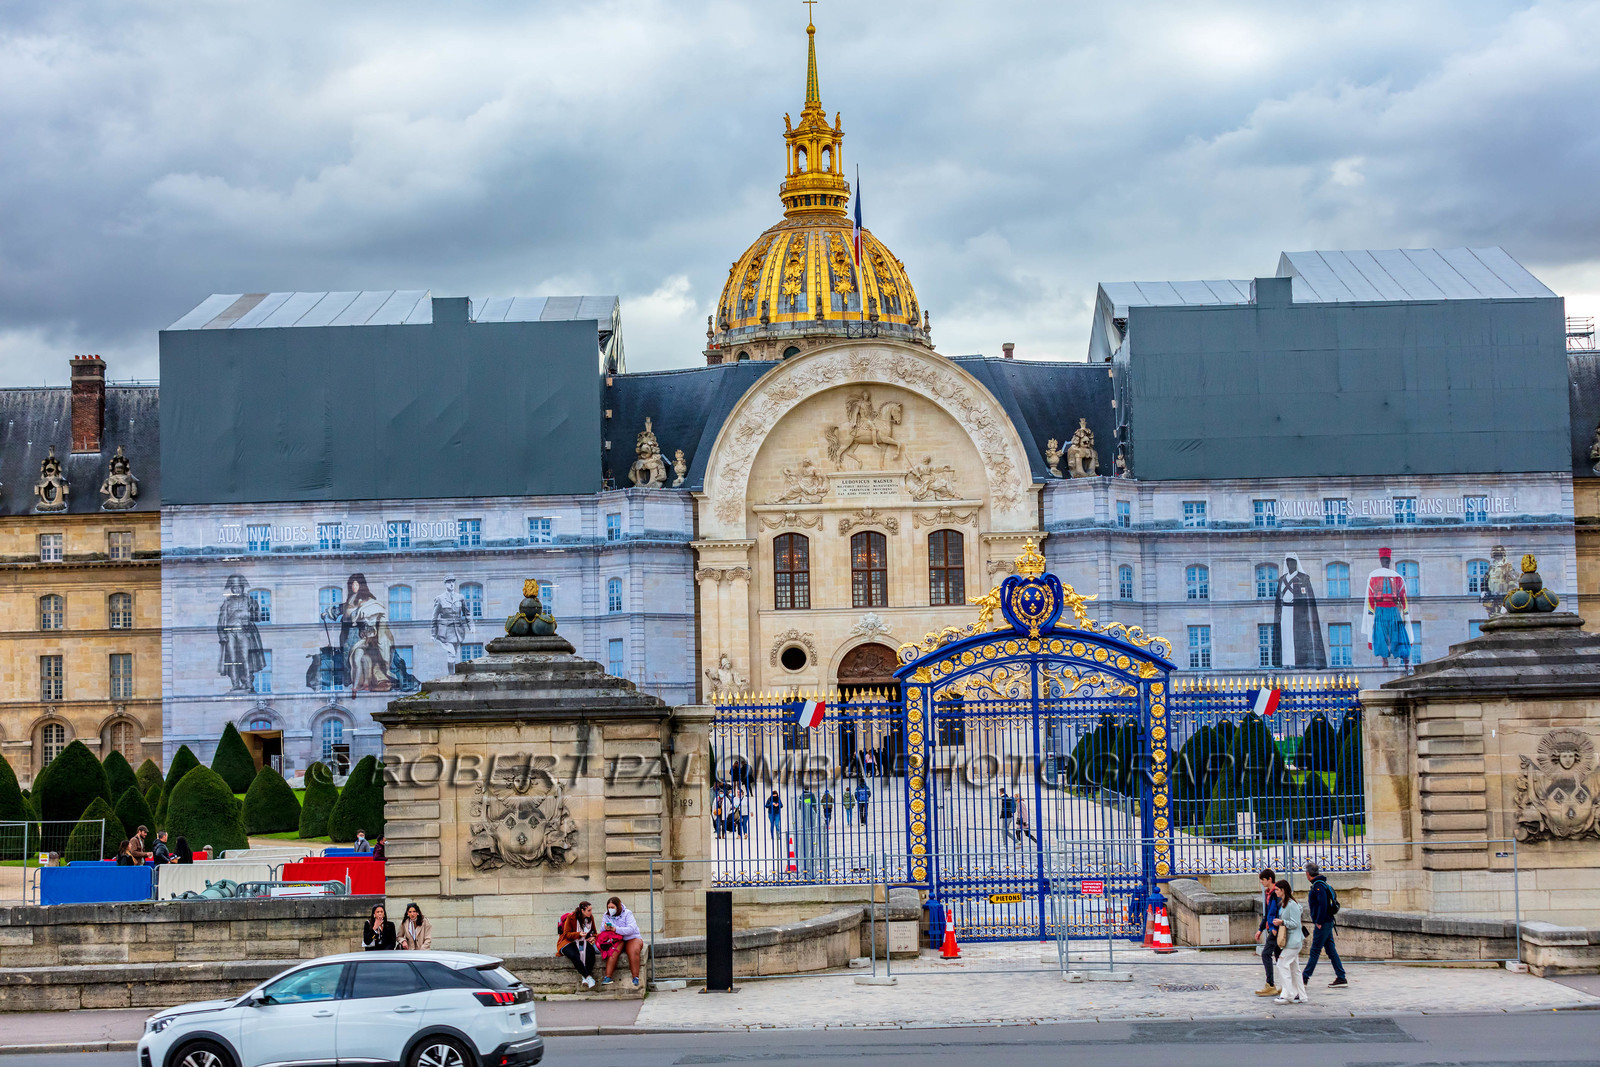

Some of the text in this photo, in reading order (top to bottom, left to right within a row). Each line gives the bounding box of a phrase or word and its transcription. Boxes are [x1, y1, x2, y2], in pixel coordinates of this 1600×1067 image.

[1266, 500, 1290, 517] AUX
[1293, 499, 1358, 517] INVALIDES,
[1362, 498, 1408, 515] ENTREZ
[1411, 498, 1443, 514] DANS
[1446, 497, 1510, 513] L'HISTOIRE
[218, 527, 242, 543] AUX
[246, 525, 312, 543] INVALIDES,
[315, 523, 360, 541] ENTREZ
[364, 522, 396, 539] DANS
[400, 521, 463, 538] L'HISTOIRE
[680, 799, 693, 807] 129
[996, 894, 1020, 902] PIETONS
